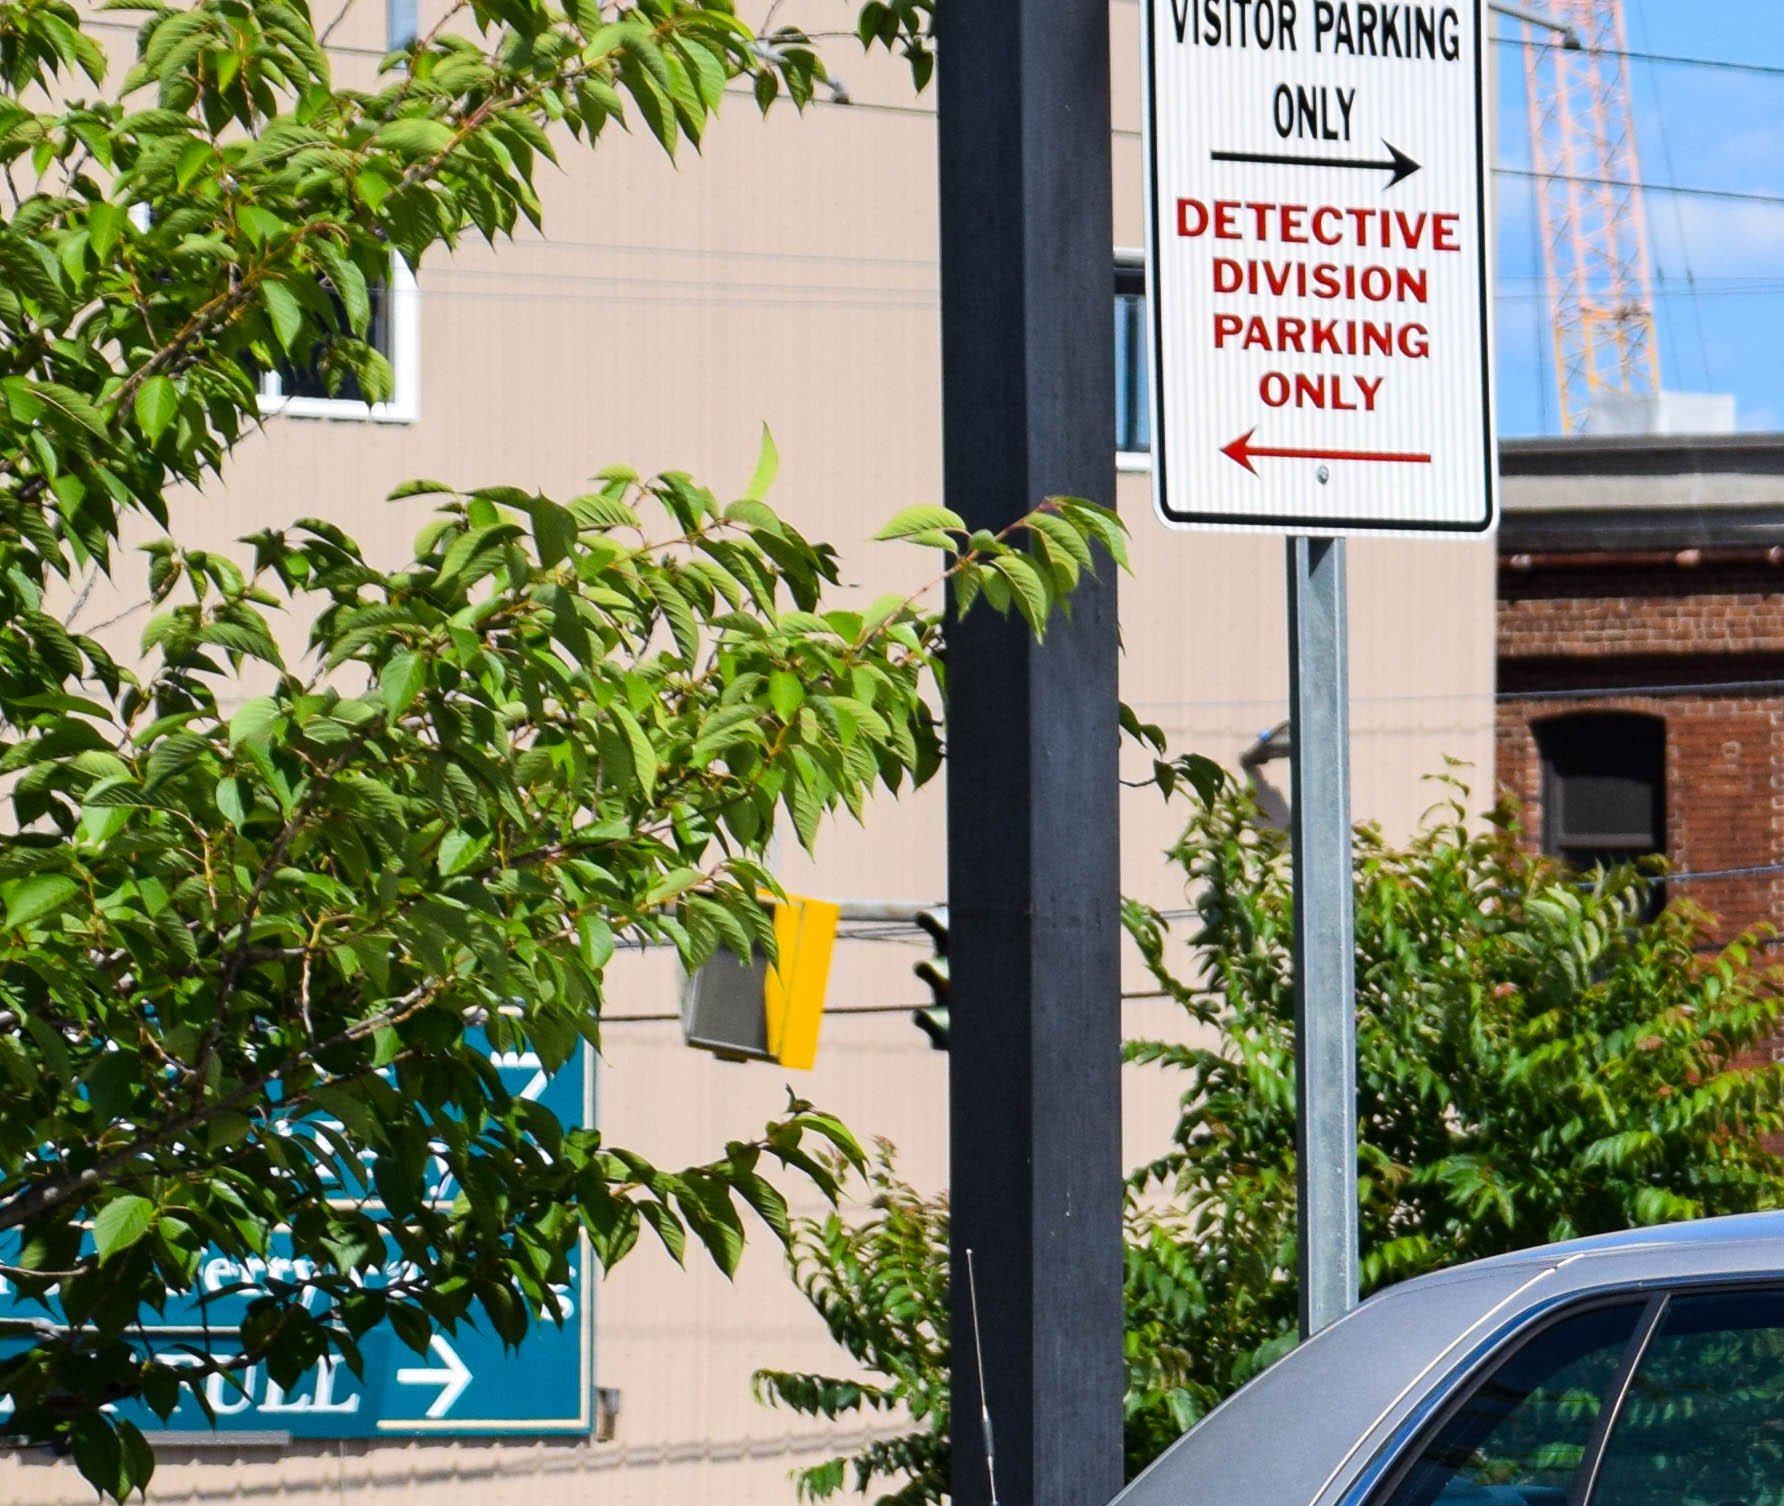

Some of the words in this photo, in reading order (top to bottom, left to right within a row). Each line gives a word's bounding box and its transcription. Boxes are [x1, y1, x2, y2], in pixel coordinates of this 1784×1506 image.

[1171, 0, 1297, 51] VISITOR
[1314, 1, 1461, 62] PARKING
[1273, 84, 1356, 142] ONLY
[1176, 198, 1462, 252] DETECTIVE
[1213, 258, 1428, 303] DIVISION
[1213, 314, 1430, 359] PARKING
[1259, 372, 1384, 412] ONLY
